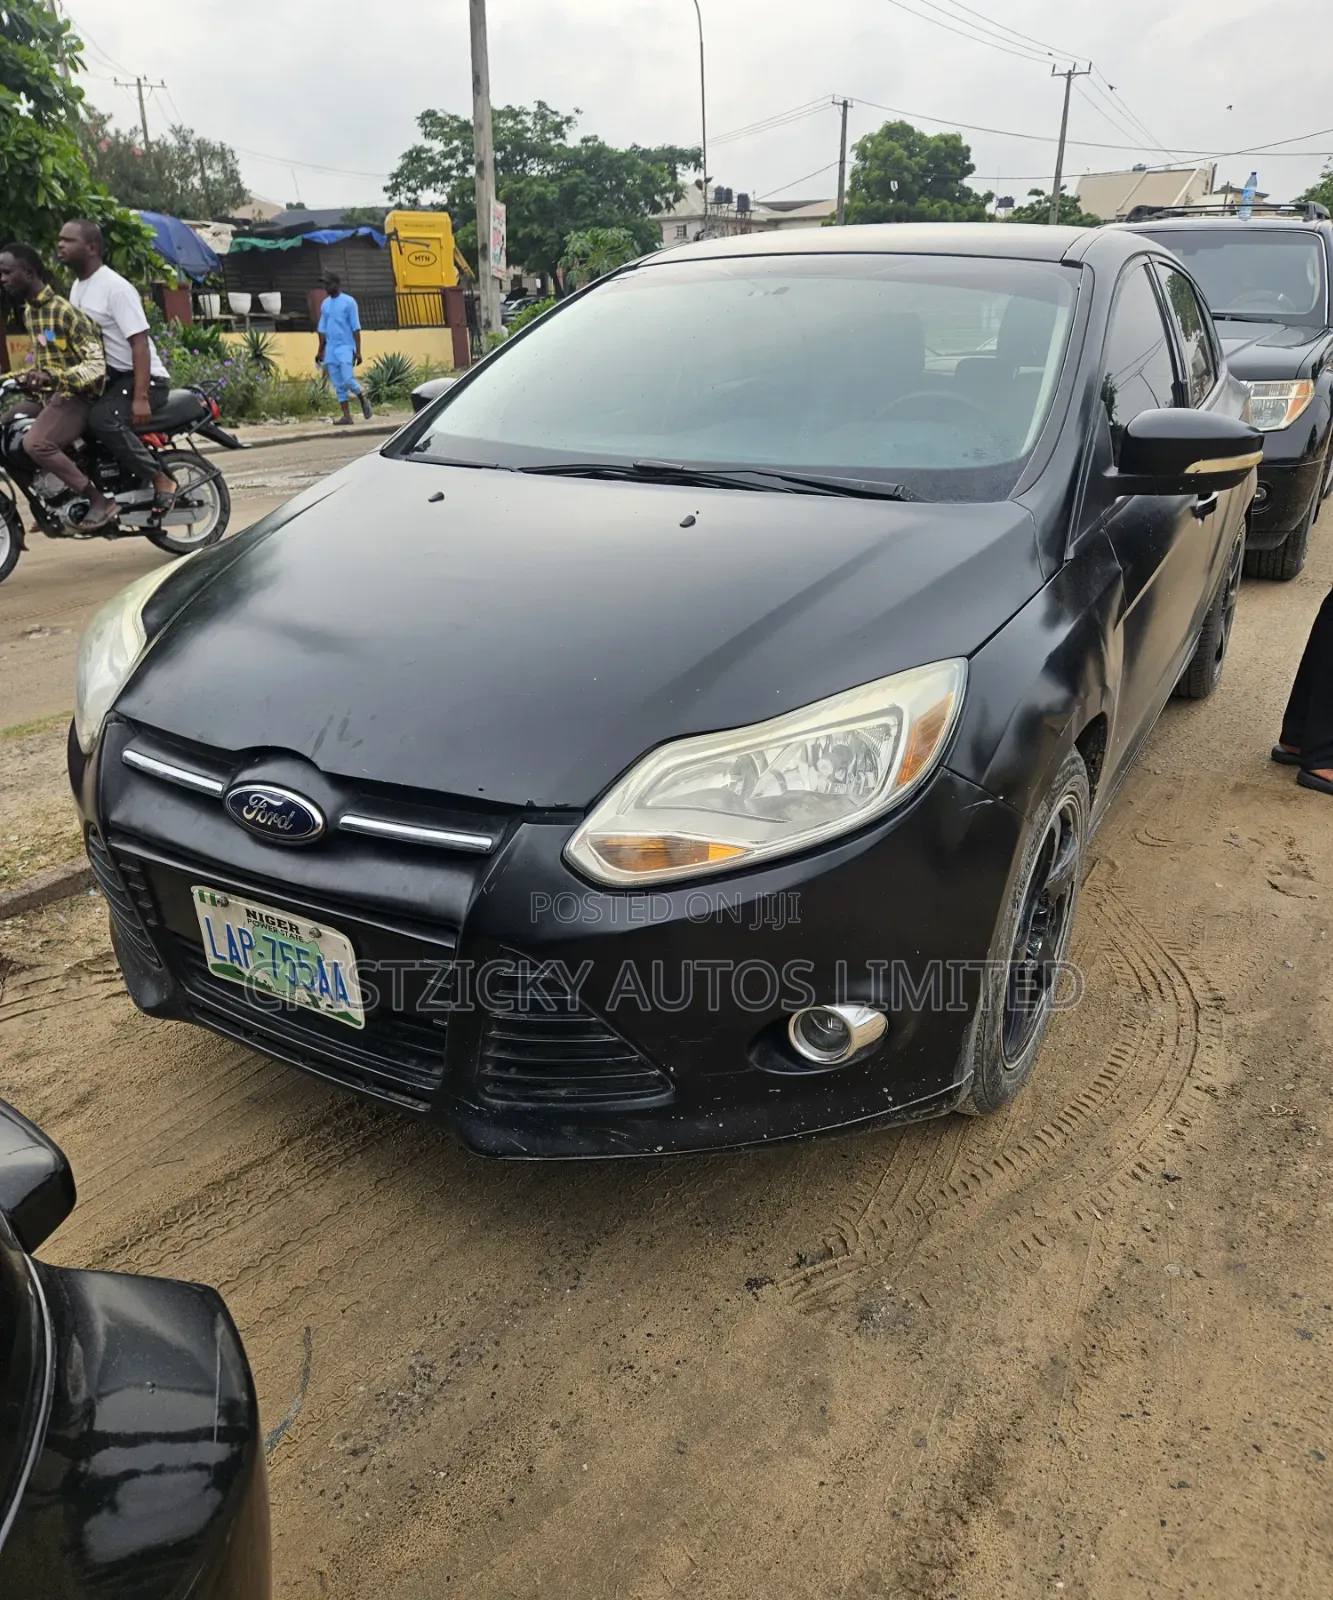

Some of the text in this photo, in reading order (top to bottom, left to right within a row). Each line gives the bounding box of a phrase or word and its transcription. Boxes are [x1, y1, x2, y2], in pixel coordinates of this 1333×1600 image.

[243, 794, 296, 830] Ford
[245, 908, 300, 934] NIGER
[247, 918, 304, 943] POWER STATE
